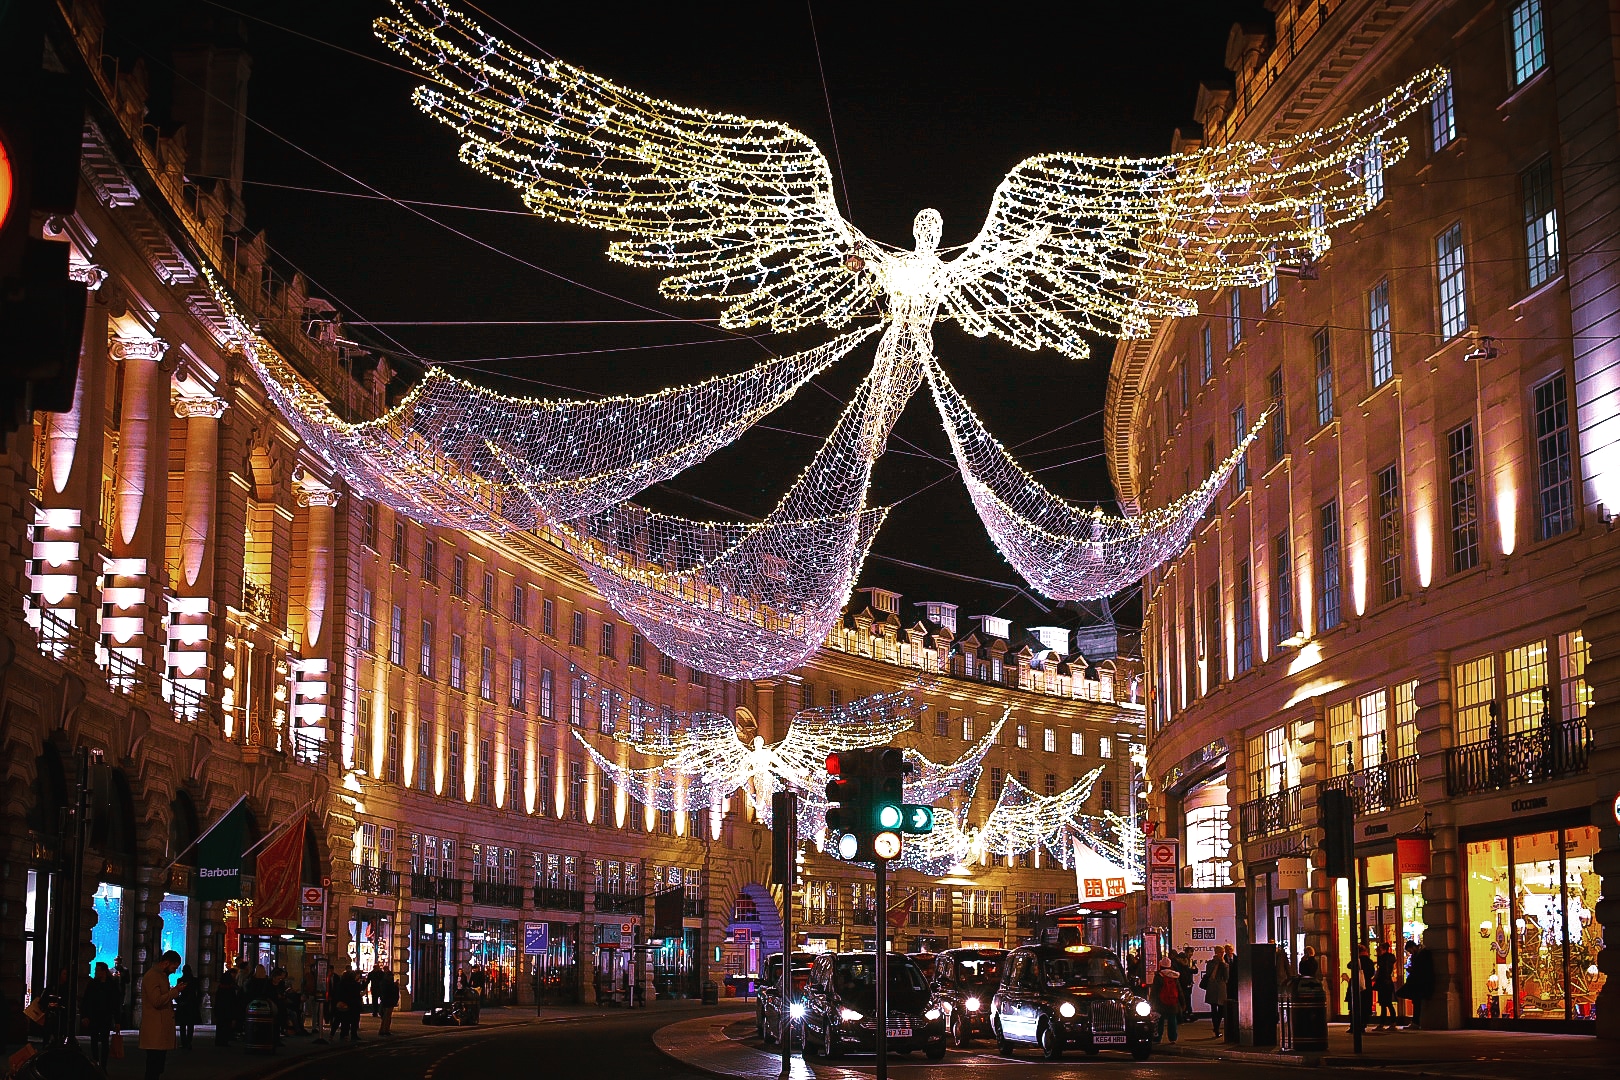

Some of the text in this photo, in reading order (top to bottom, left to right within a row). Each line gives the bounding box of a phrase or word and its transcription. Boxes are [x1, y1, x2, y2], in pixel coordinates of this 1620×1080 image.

[1143, 823, 1150, 832] F
[199, 867, 239, 878] Barbour
[323, 878, 331, 886] D
[1107, 879, 1123, 887] UNI
[1109, 888, 1125, 896] QLO
